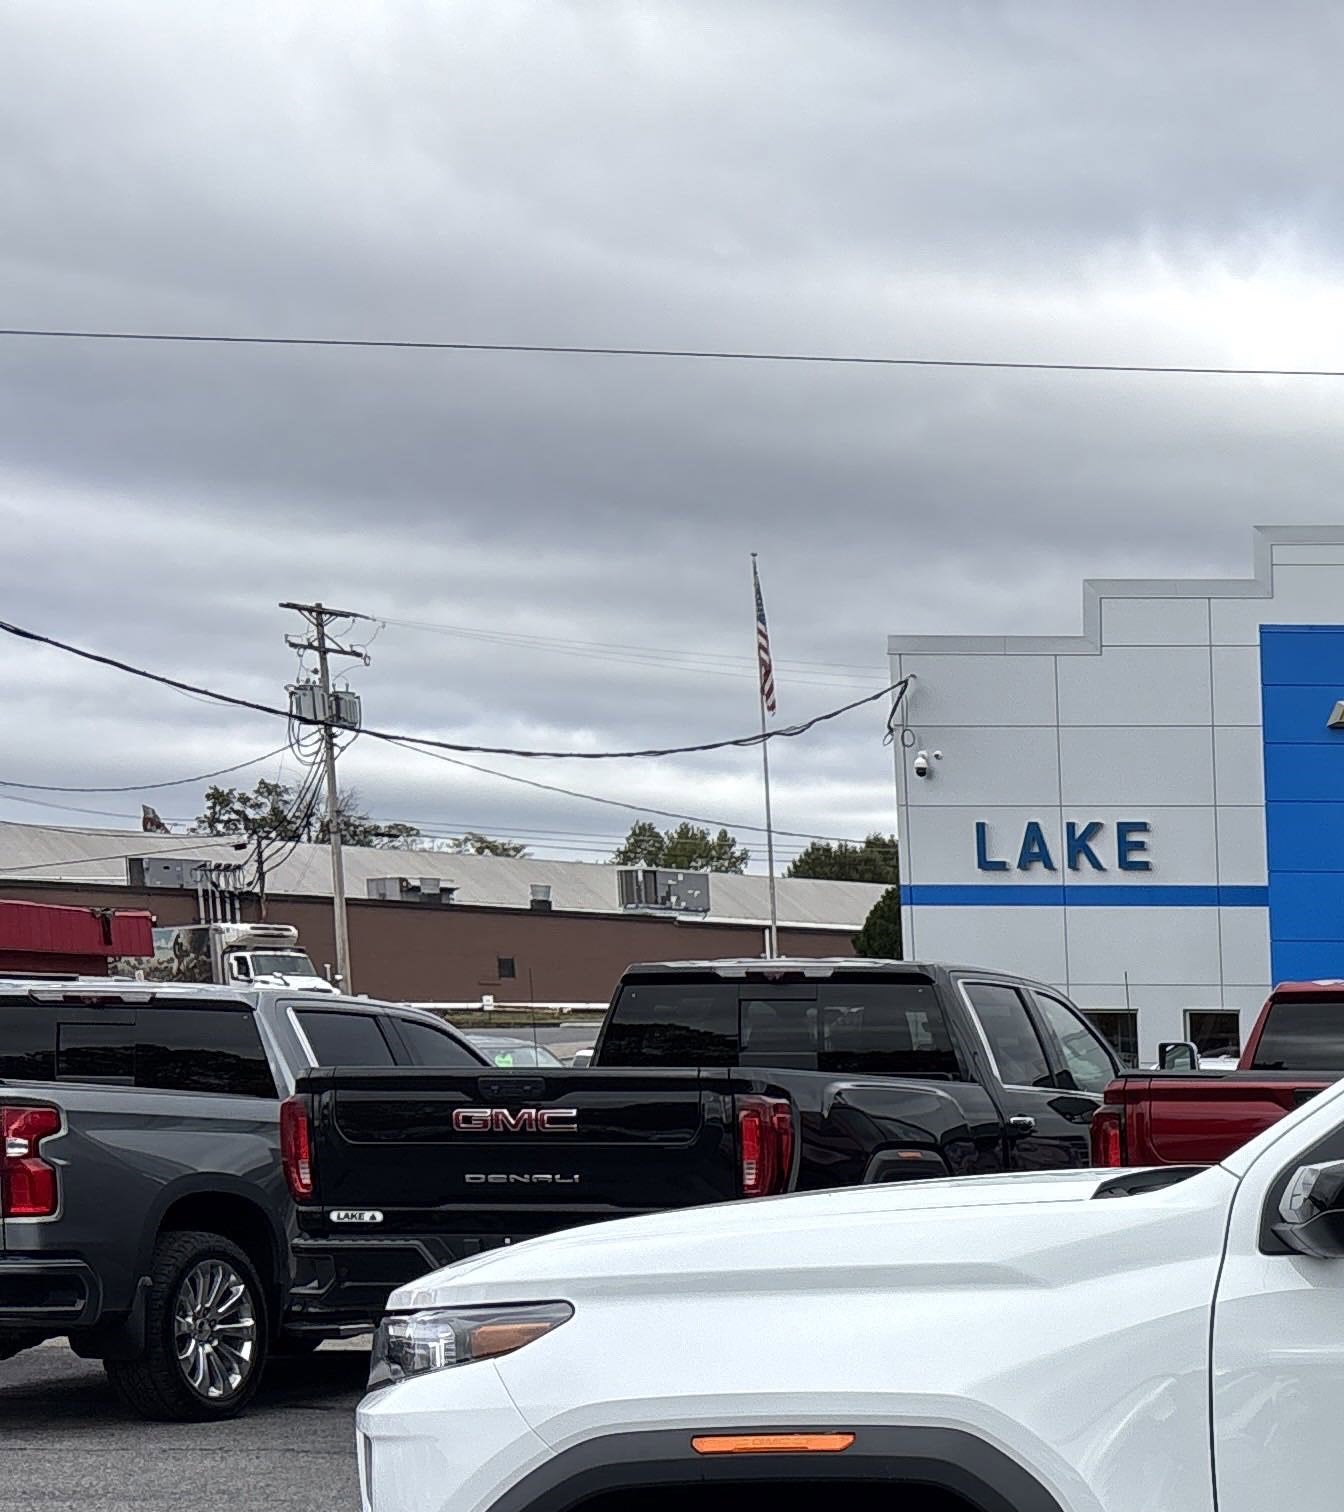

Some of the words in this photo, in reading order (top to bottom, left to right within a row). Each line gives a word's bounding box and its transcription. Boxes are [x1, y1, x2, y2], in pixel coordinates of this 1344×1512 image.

[975, 821, 1152, 872] LAKE
[453, 1108, 578, 1132] GMC
[465, 1174, 580, 1183] DENALI
[336, 1212, 366, 1221] LAKE
